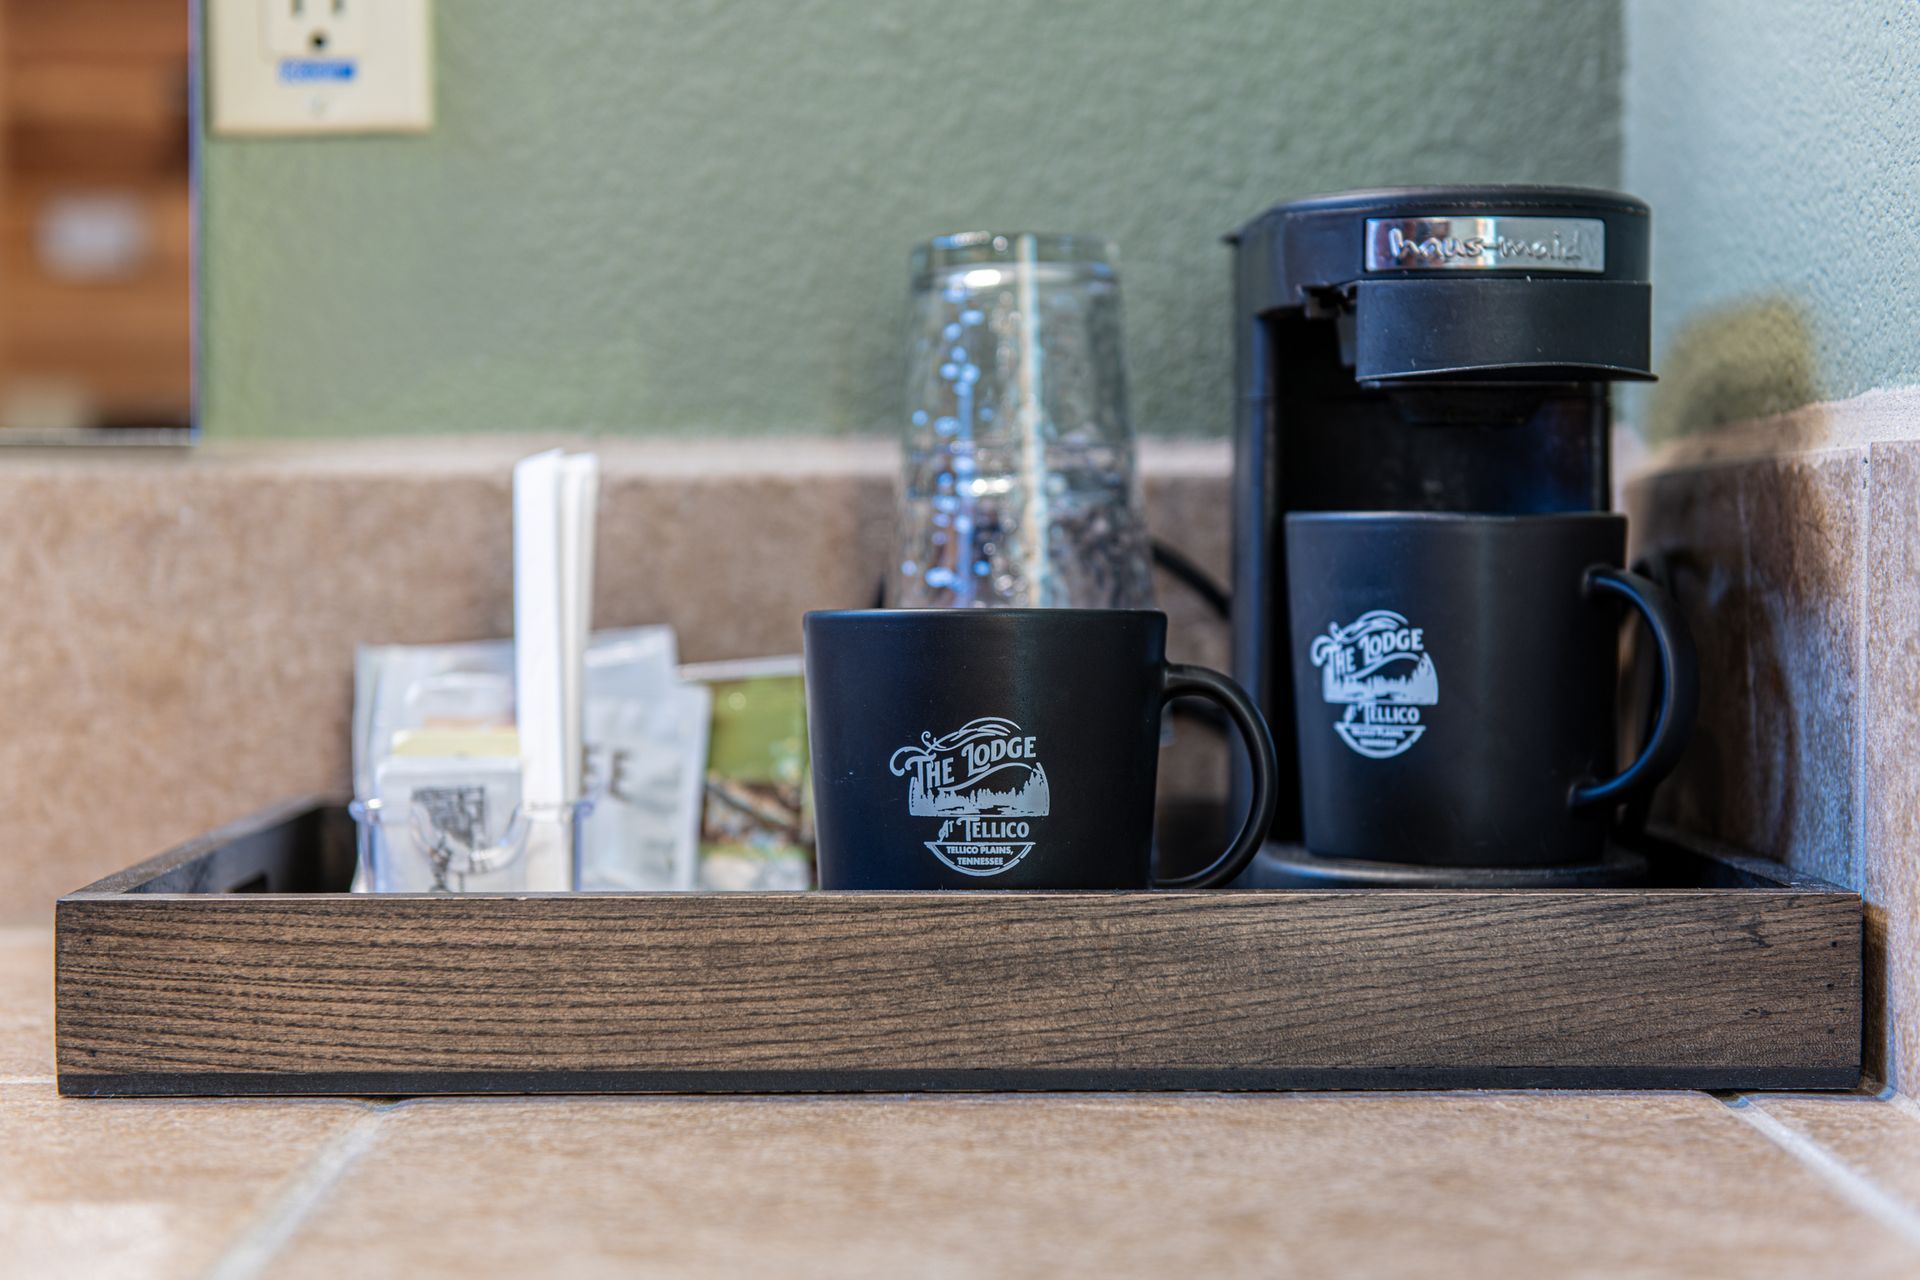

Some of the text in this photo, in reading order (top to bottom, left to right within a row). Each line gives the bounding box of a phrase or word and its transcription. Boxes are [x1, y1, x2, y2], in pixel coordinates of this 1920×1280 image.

[1311, 628, 1424, 680] THE LODGE
[1357, 702, 1420, 725] TELLICO
[891, 736, 1037, 795] THE LODGE
[955, 816, 1030, 842] TELLICO
[946, 846, 1014, 856] TELLICO PLAINS,
[957, 857, 1003, 866] TENNESSEE
